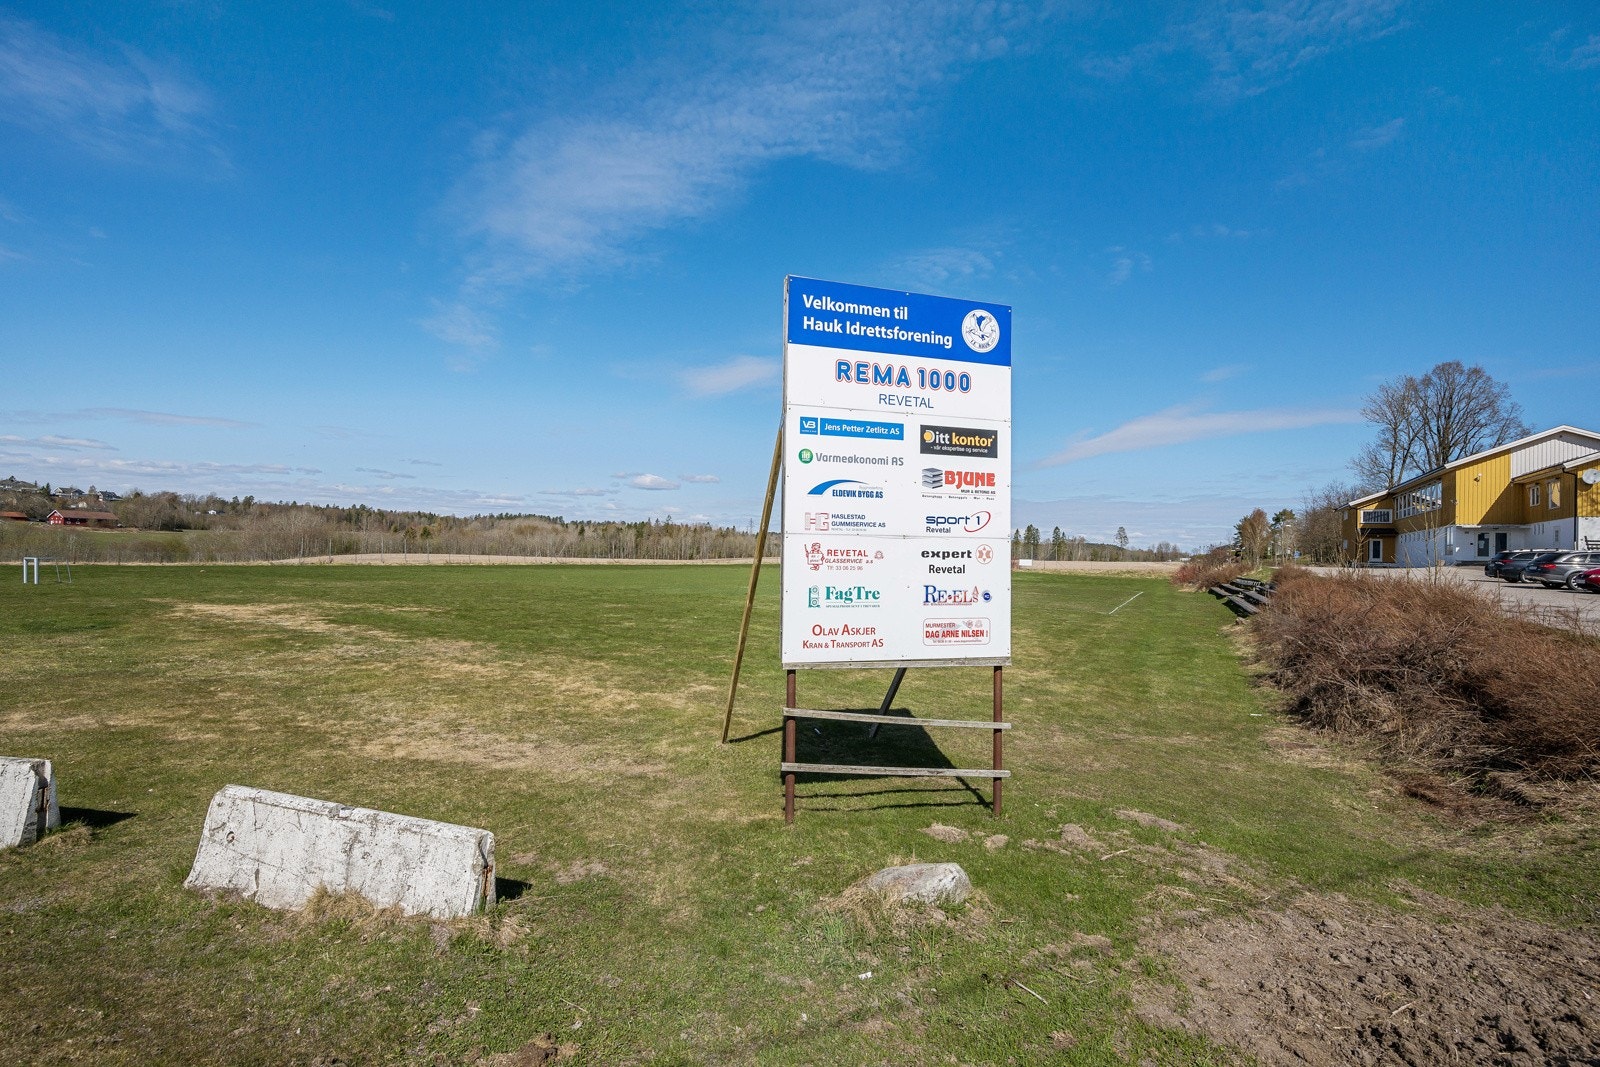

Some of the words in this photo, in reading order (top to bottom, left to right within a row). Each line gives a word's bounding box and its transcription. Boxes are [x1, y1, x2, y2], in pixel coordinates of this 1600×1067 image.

[802, 294, 890, 318] Velkommen
[893, 306, 908, 320] til
[803, 316, 843, 333] Hauk
[846, 321, 953, 349] Idrettsforening
[835, 359, 912, 388] REMA
[917, 367, 972, 394] 1000
[879, 394, 934, 409] REVETAL
[824, 423, 841, 431] Jens
[842, 424, 864, 432] Petter
[866, 425, 888, 435] Zetlitz
[889, 427, 900, 435] AS
[923, 429, 950, 445] Ditt
[952, 432, 994, 447] kontor
[815, 452, 889, 466] Varmeøkonomi
[891, 456, 904, 467] AS
[944, 470, 996, 489] BJUNE
[832, 489, 857, 498] ELDEVIK
[857, 490, 875, 499] BYGG
[875, 490, 884, 499] AS
[831, 520, 877, 528] GUMMISERVICE
[925, 515, 970, 526] sport
[976, 515, 980, 525] 1
[925, 526, 951, 534] Revetal
[826, 549, 869, 557] REVETAL
[921, 550, 972, 560] expert
[928, 564, 966, 574] Revetal
[825, 585, 881, 604] FagTre
[925, 630, 940, 639] DAG
[941, 630, 959, 638] ARNE
[961, 629, 985, 638] NILSEN
[871, 638, 884, 648] AS
